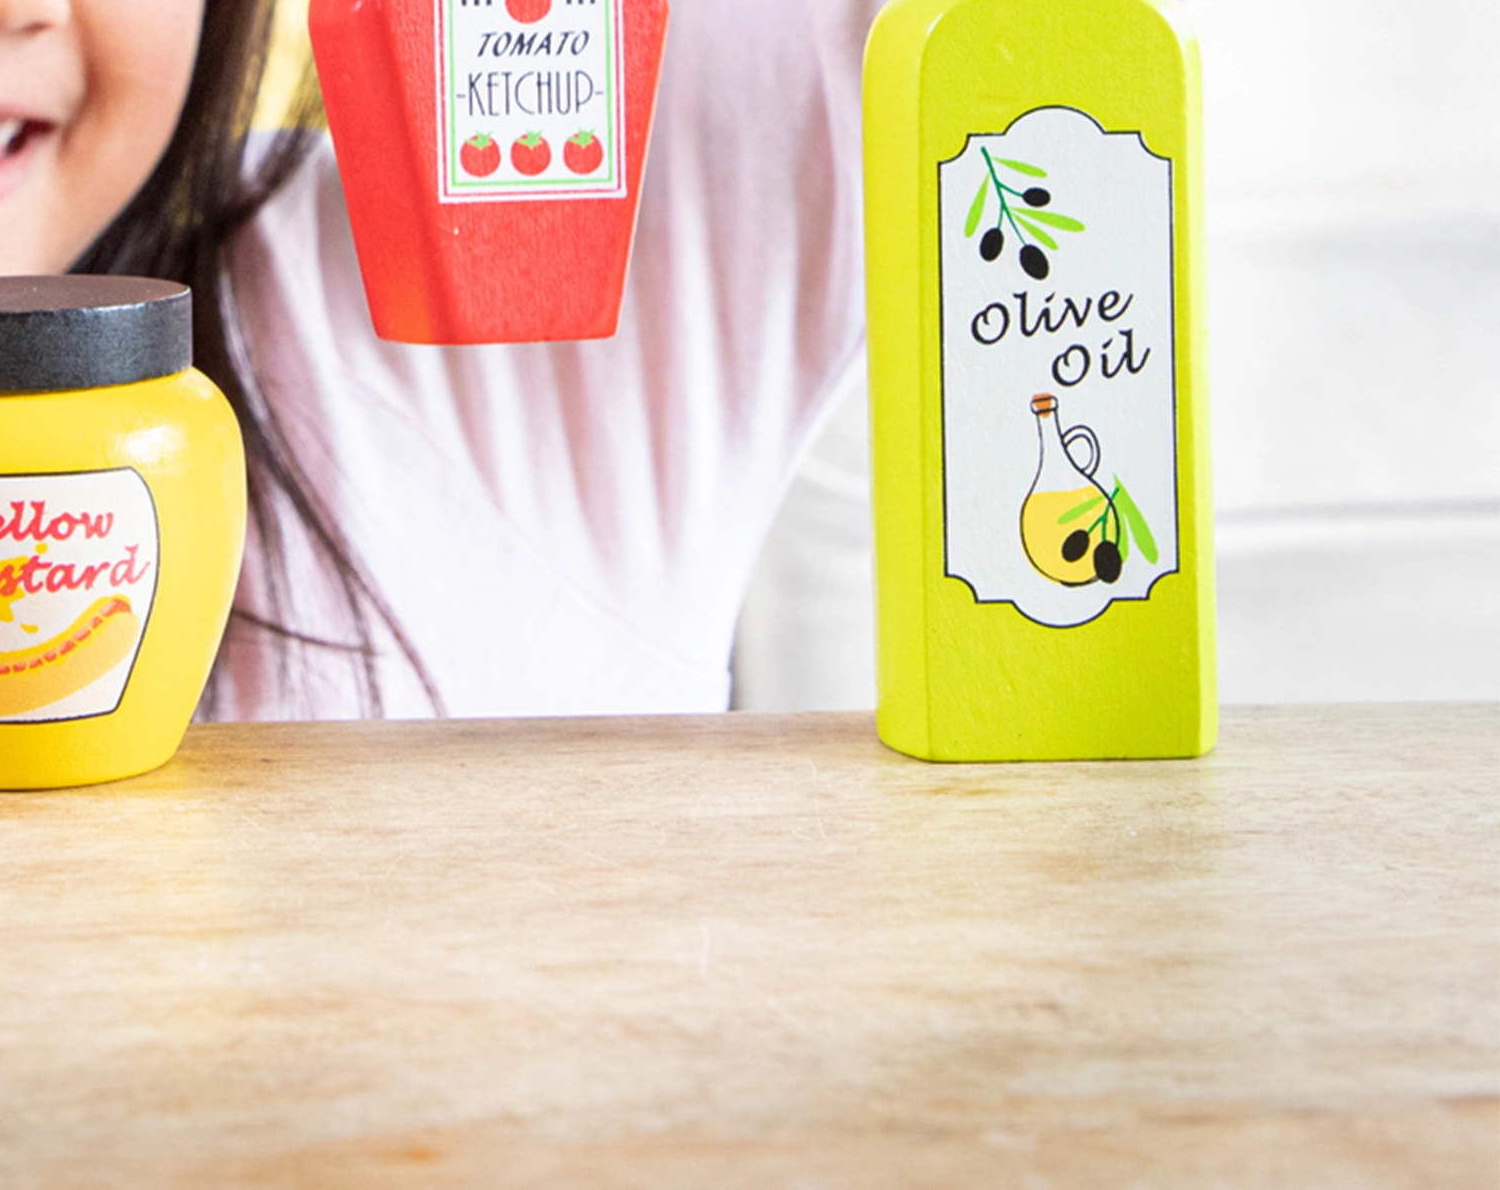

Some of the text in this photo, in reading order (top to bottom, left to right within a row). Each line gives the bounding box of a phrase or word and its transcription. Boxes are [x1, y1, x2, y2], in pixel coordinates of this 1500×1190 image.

[477, 30, 590, 57] TOMATO
[970, 289, 1135, 345] Olive
[1051, 328, 1151, 388] Oil
